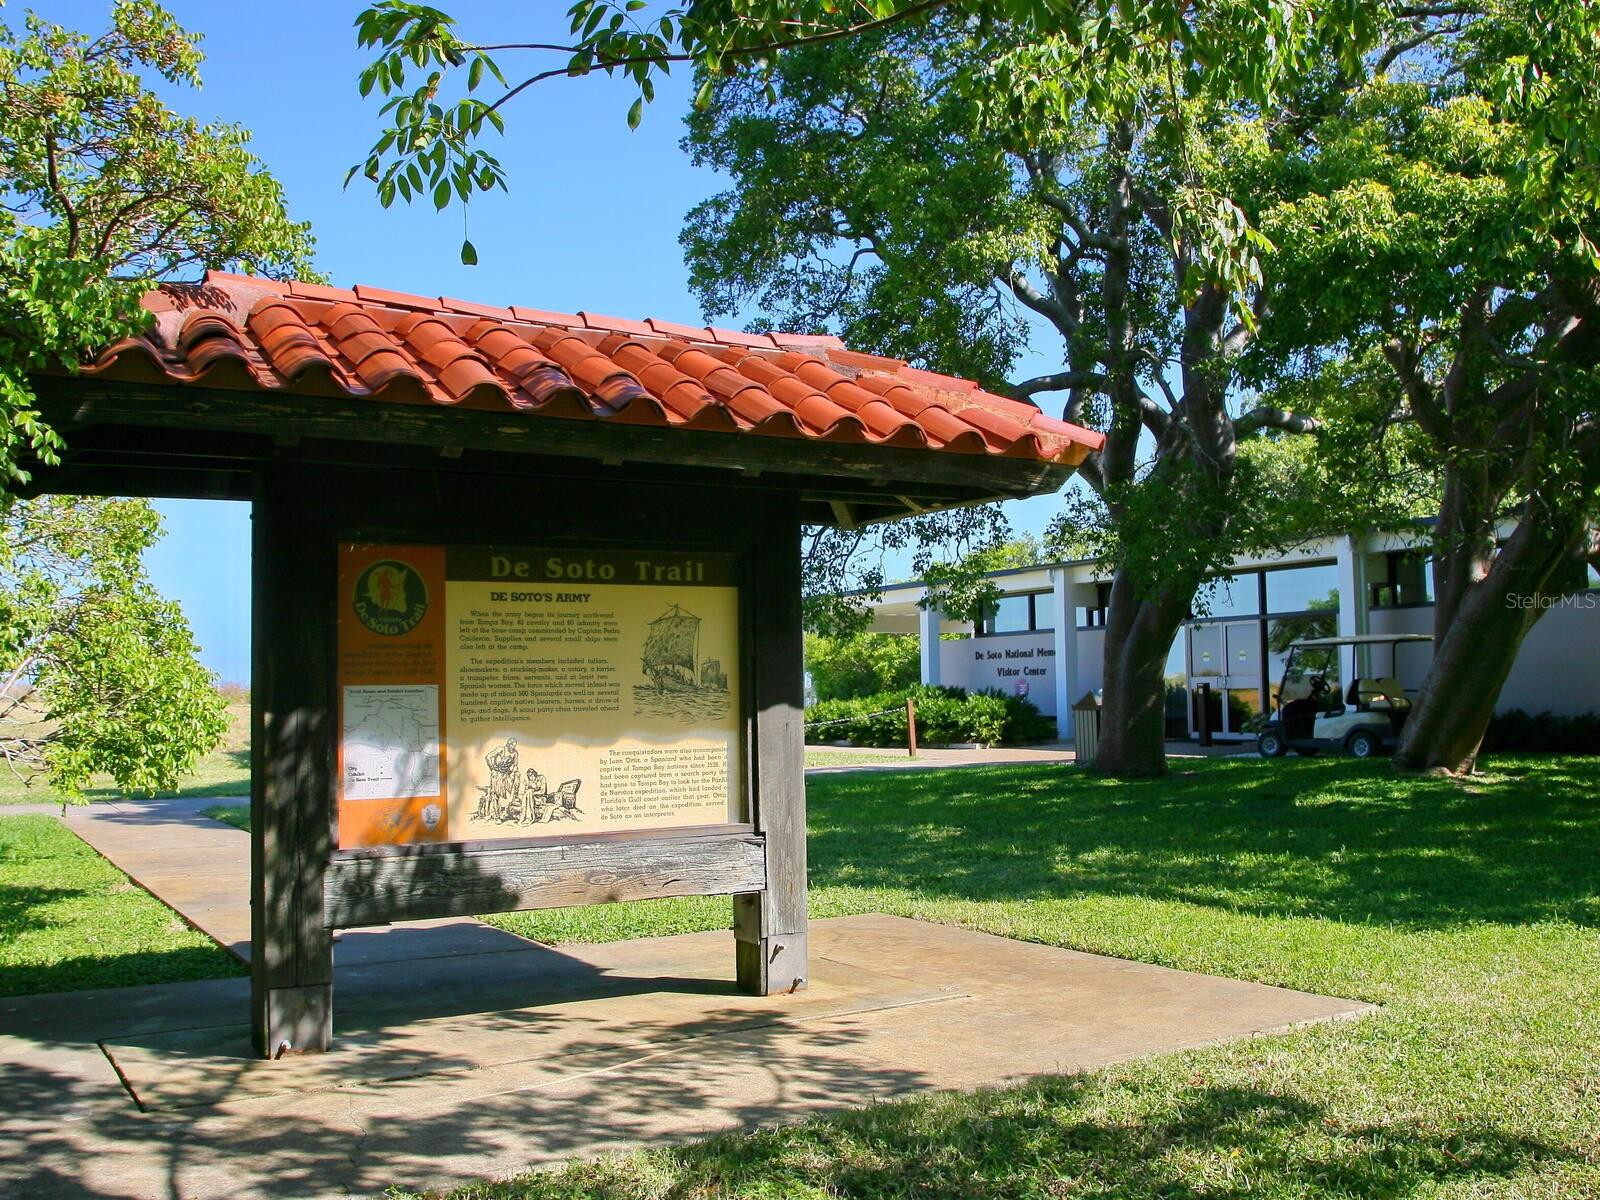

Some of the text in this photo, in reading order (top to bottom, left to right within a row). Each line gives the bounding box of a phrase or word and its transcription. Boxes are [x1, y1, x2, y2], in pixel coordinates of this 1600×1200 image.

[491, 556, 704, 581] De Soto Trail
[491, 592, 591, 603] DE SOTO'S ARMY
[355, 602, 425, 633] De Soto Trail
[494, 635, 522, 643] Supplies
[976, 651, 983, 660] De
[1005, 649, 1033, 658] National
[997, 666, 1046, 677] Visitor Center
[460, 683, 486, 691] Spanish
[490, 699, 513, 707] captive
